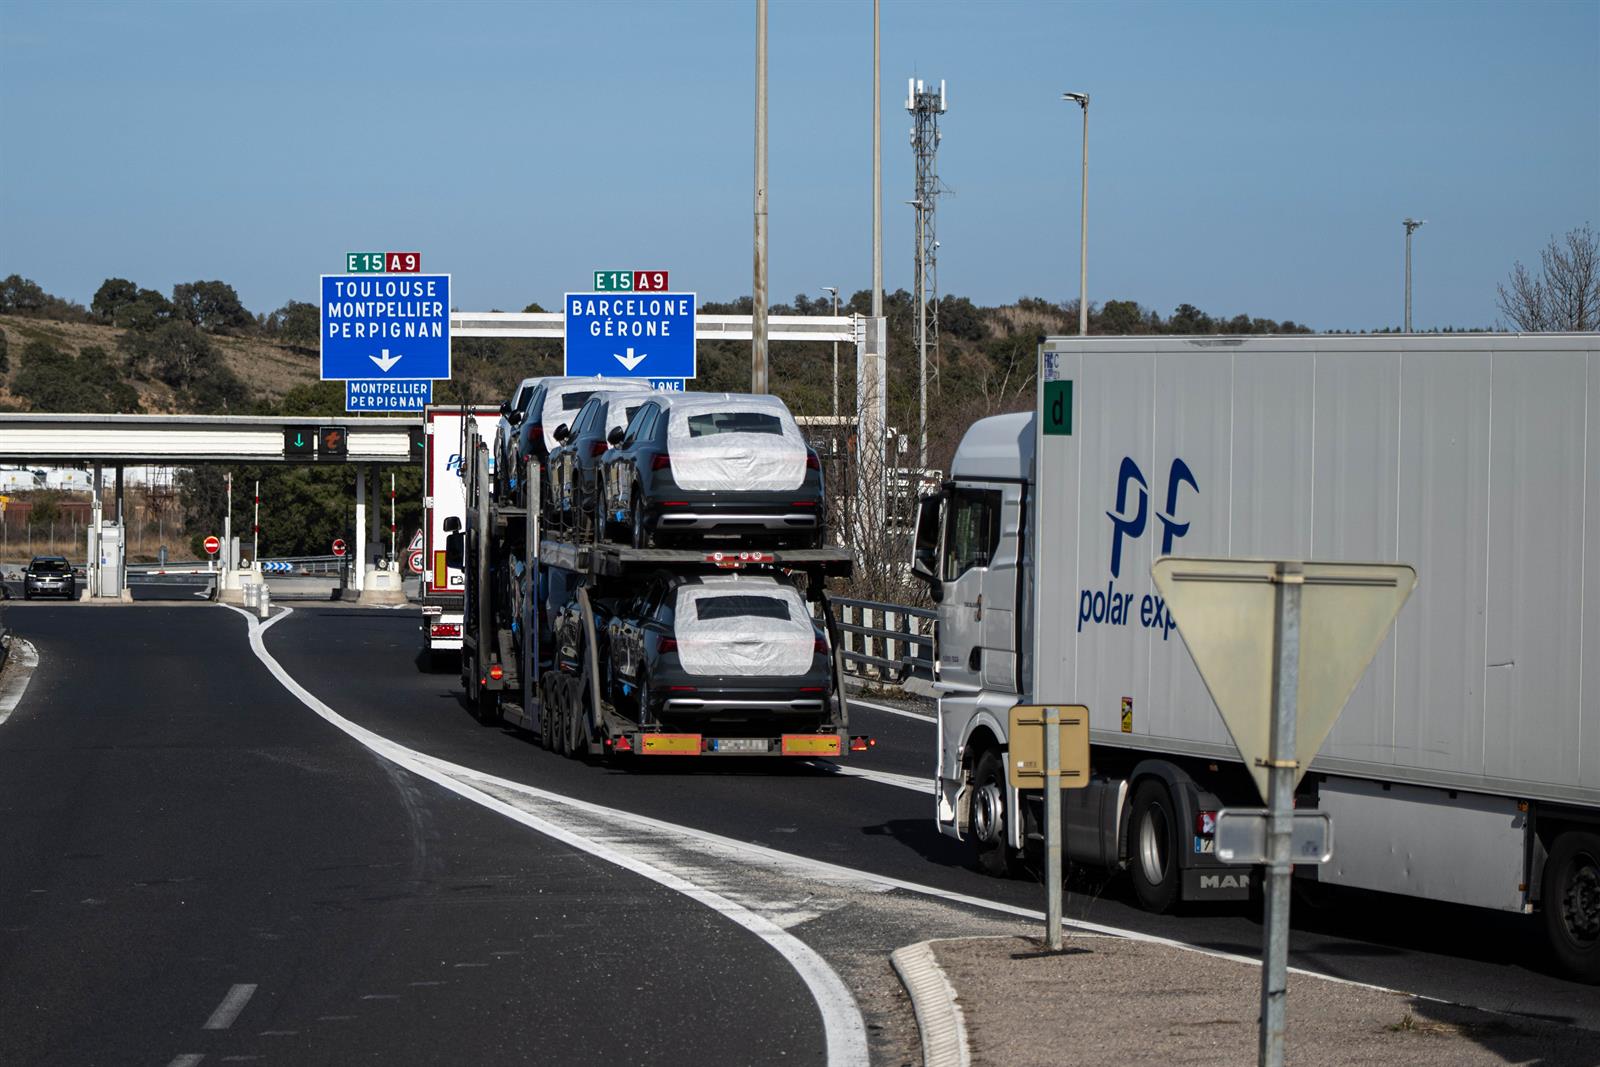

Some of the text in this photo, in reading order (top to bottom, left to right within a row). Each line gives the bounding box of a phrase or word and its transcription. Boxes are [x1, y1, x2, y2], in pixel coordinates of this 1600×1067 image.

[335, 281, 437, 298] TOULOUSE
[328, 301, 443, 318] MONTPELLIER
[572, 299, 689, 316] BARCELONE
[329, 321, 443, 339] PERPIGNAN
[590, 317, 670, 337] GÉRONE
[351, 382, 428, 394] MONTPELLIER
[351, 396, 424, 407] PERPIGNAN
[1077, 581, 1177, 641] polar exp
